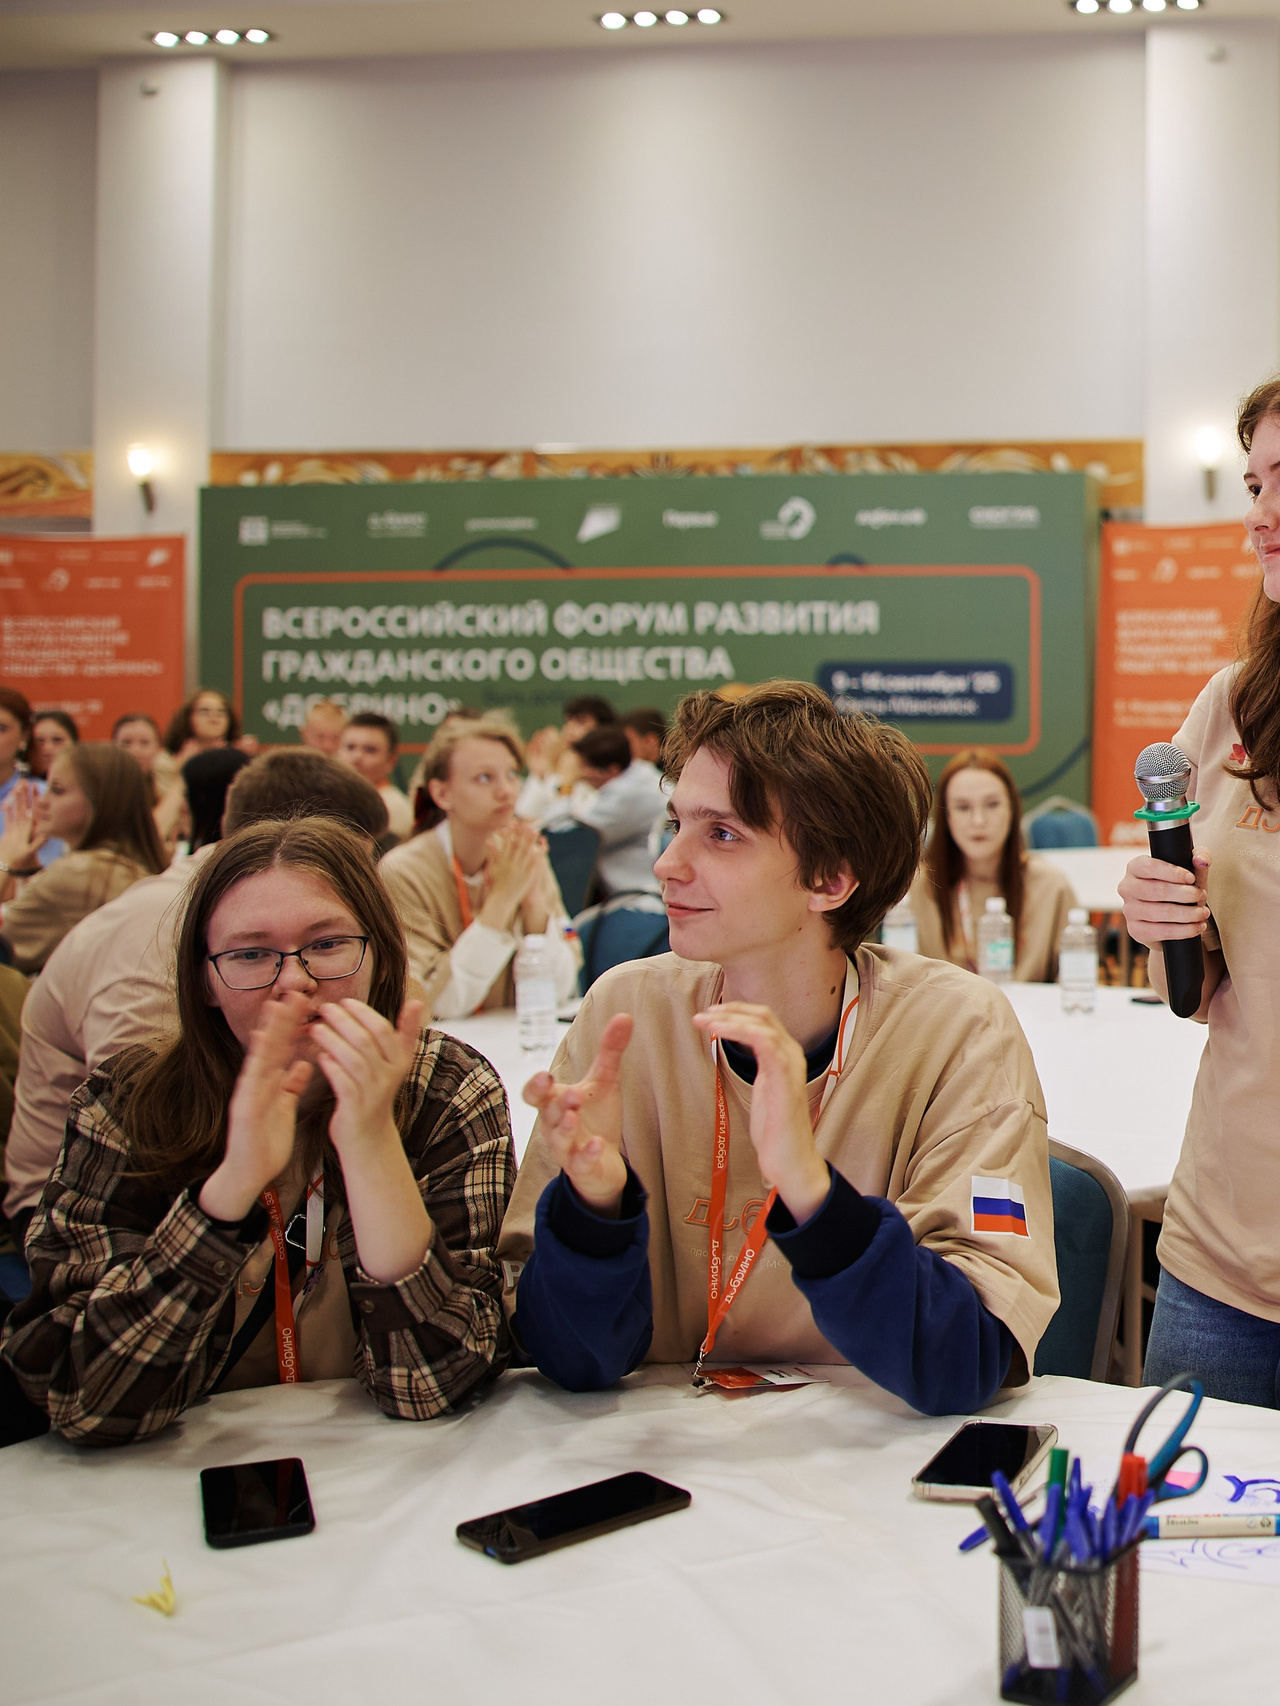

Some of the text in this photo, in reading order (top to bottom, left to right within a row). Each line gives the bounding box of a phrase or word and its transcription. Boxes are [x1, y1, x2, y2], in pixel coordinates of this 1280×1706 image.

[262, 599, 881, 640] ВСЕРОССИЙСКИЙ ФОРУМ РАЗВИТИЯ
[261, 645, 735, 688] ГРАЖДАНСКОГО ОБЩЕСТВА
[716, 1135, 727, 1169] добра
[709, 1239, 721, 1299] добрино
[724, 1248, 756, 1305] добрино
